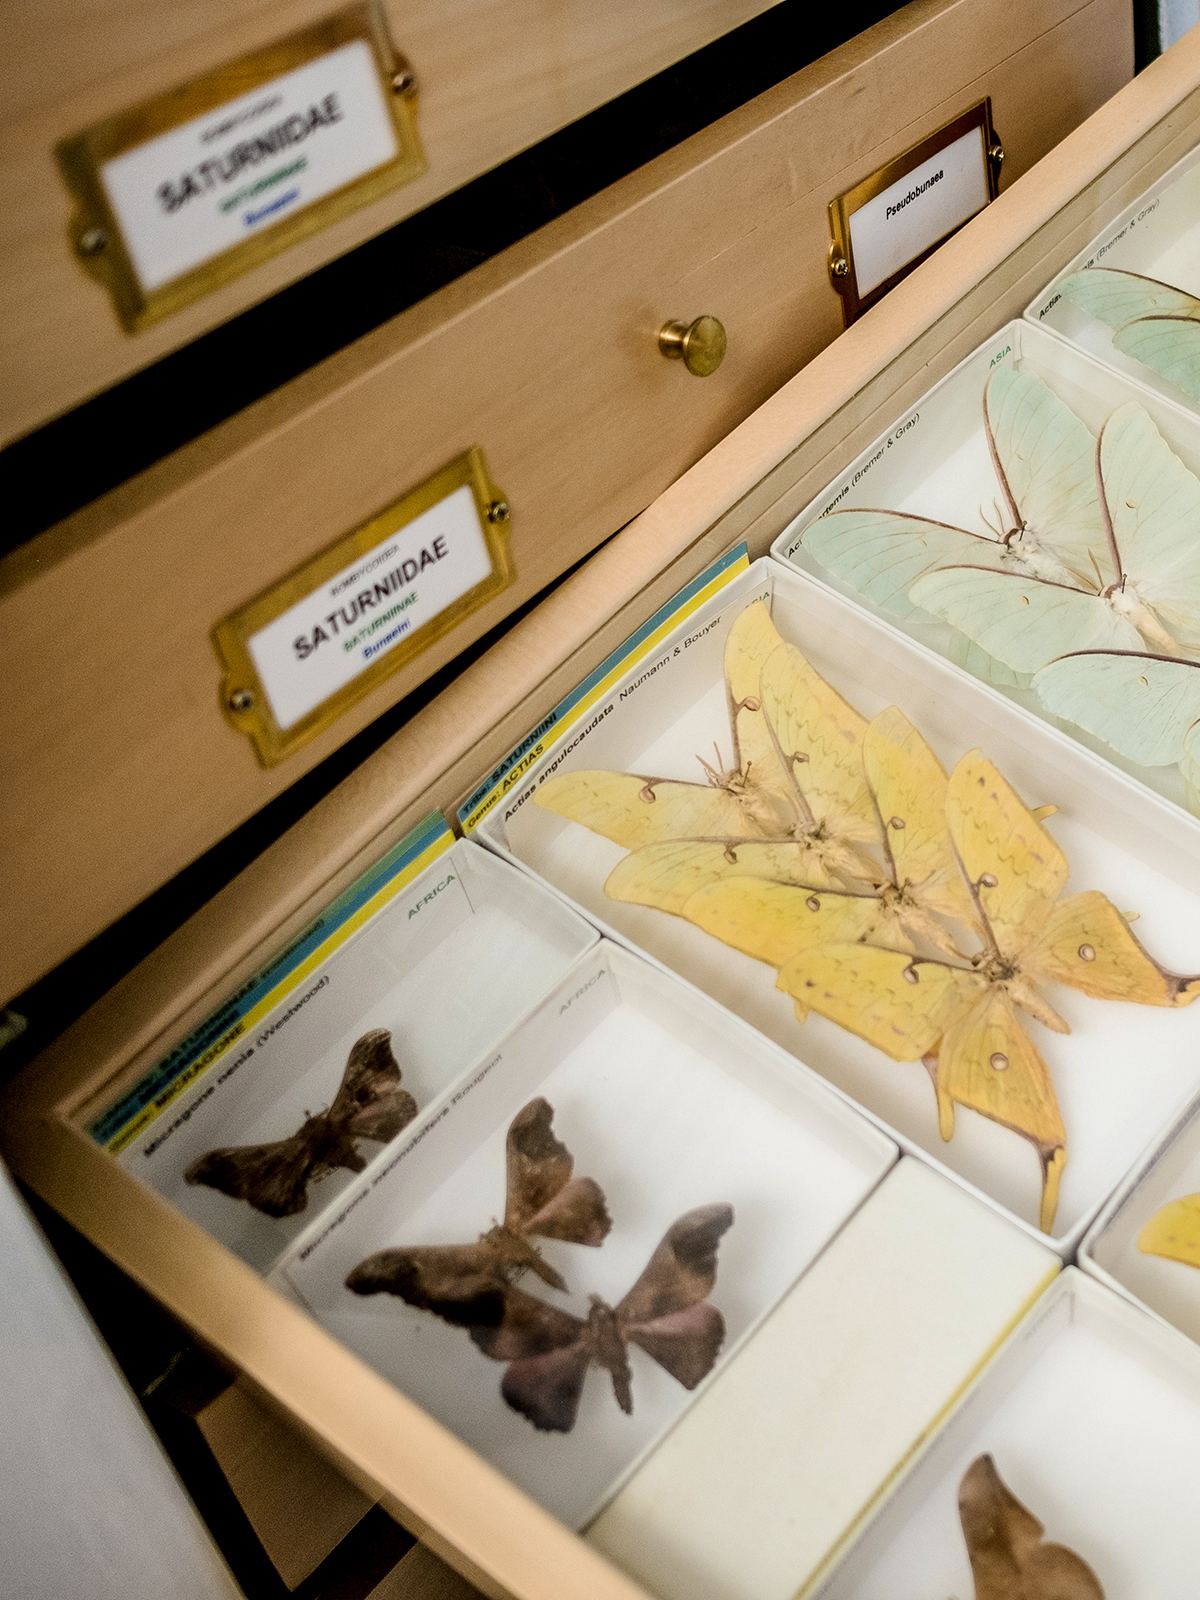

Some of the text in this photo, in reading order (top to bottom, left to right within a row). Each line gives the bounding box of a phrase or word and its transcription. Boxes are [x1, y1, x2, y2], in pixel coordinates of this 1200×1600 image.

[155, 90, 345, 217] SATURNIIDAE
[885, 168, 945, 221] Pseudobunaea
[989, 344, 1013, 370] ASIA
[850, 447, 885, 488] (Bremer
[886, 437, 894, 450] &
[894, 412, 921, 441] Gray)
[292, 533, 450, 662] SATURNIIDAE
[342, 591, 420, 654] SATURNIINAE
[503, 615, 723, 823] Actias angulocaudata Naumann & Bouyer
[501, 743, 546, 792] ACTIAS
[408, 874, 457, 921] AFRICA
[255, 975, 331, 1049] (Westwood)
[558, 968, 607, 1018] AFRICA
